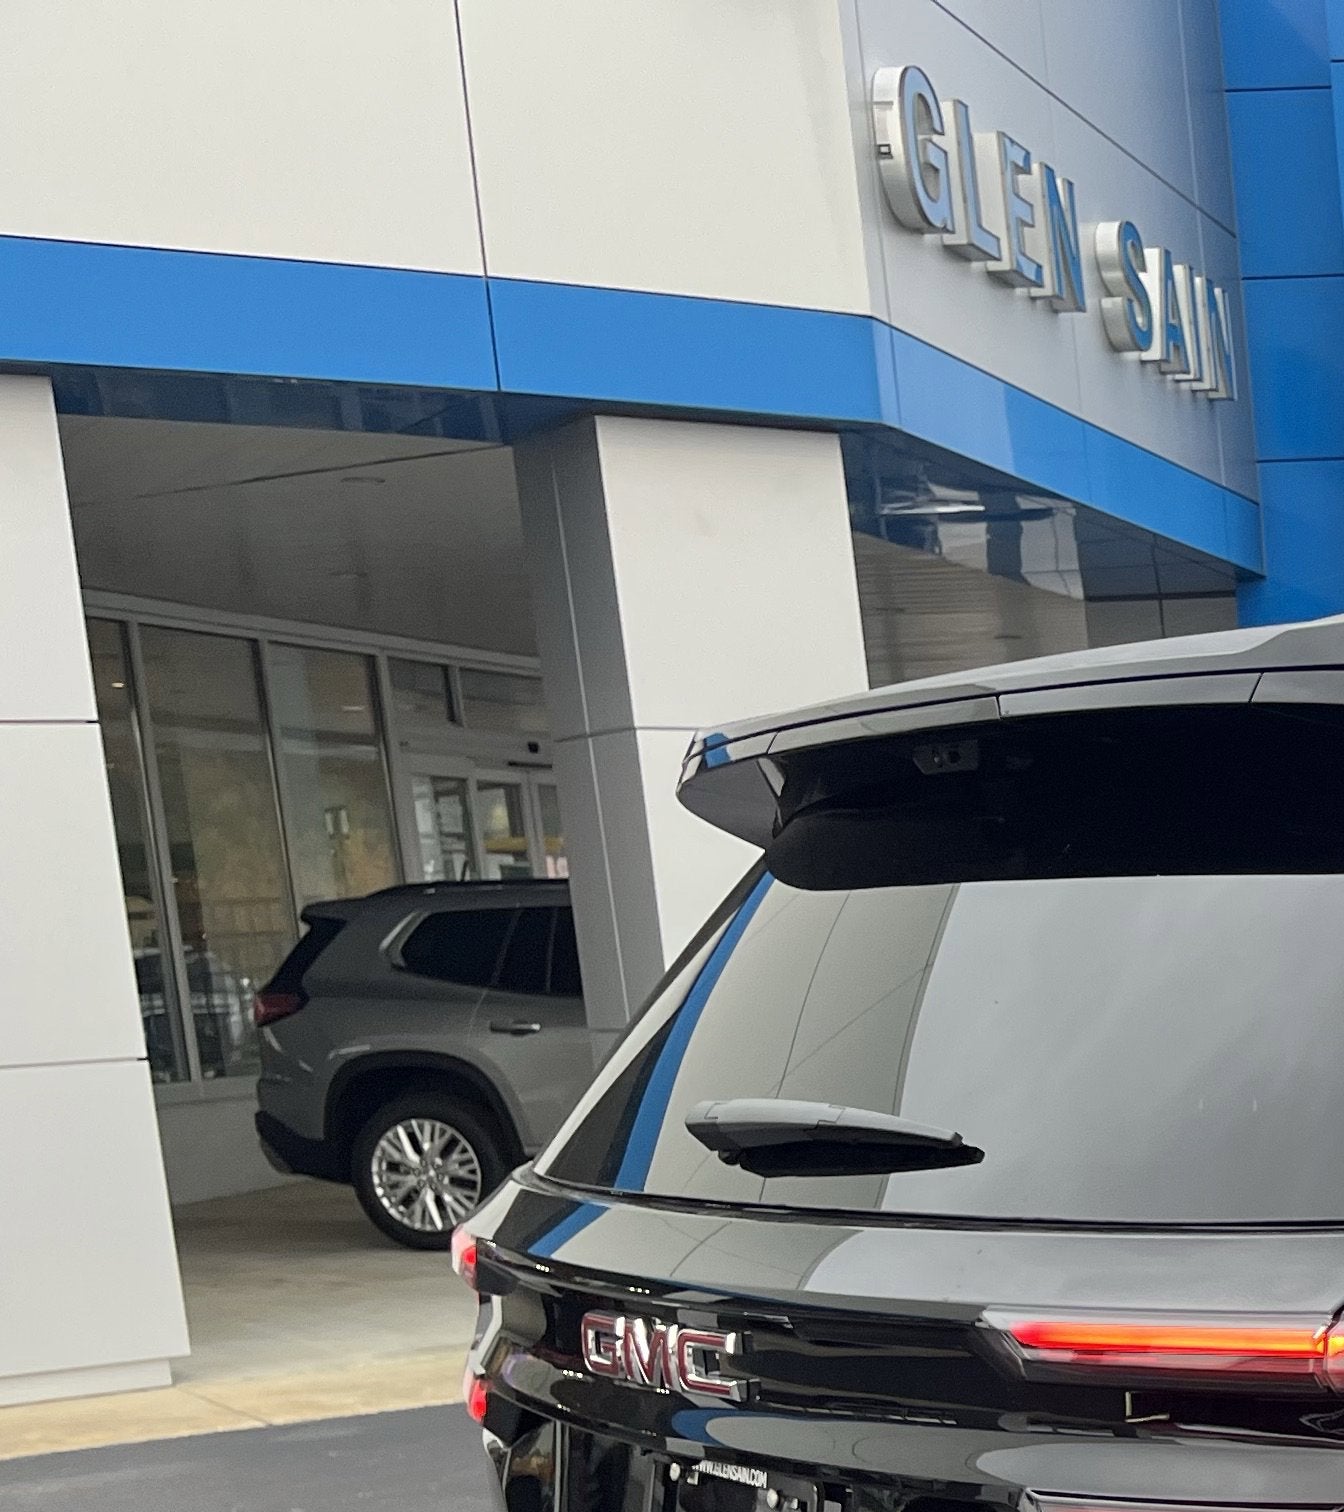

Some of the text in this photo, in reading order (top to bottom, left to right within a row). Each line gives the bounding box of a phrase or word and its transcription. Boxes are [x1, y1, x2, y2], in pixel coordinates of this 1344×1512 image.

[873, 65, 1238, 401] GLEN SAIN
[581, 1310, 748, 1402] GMC
